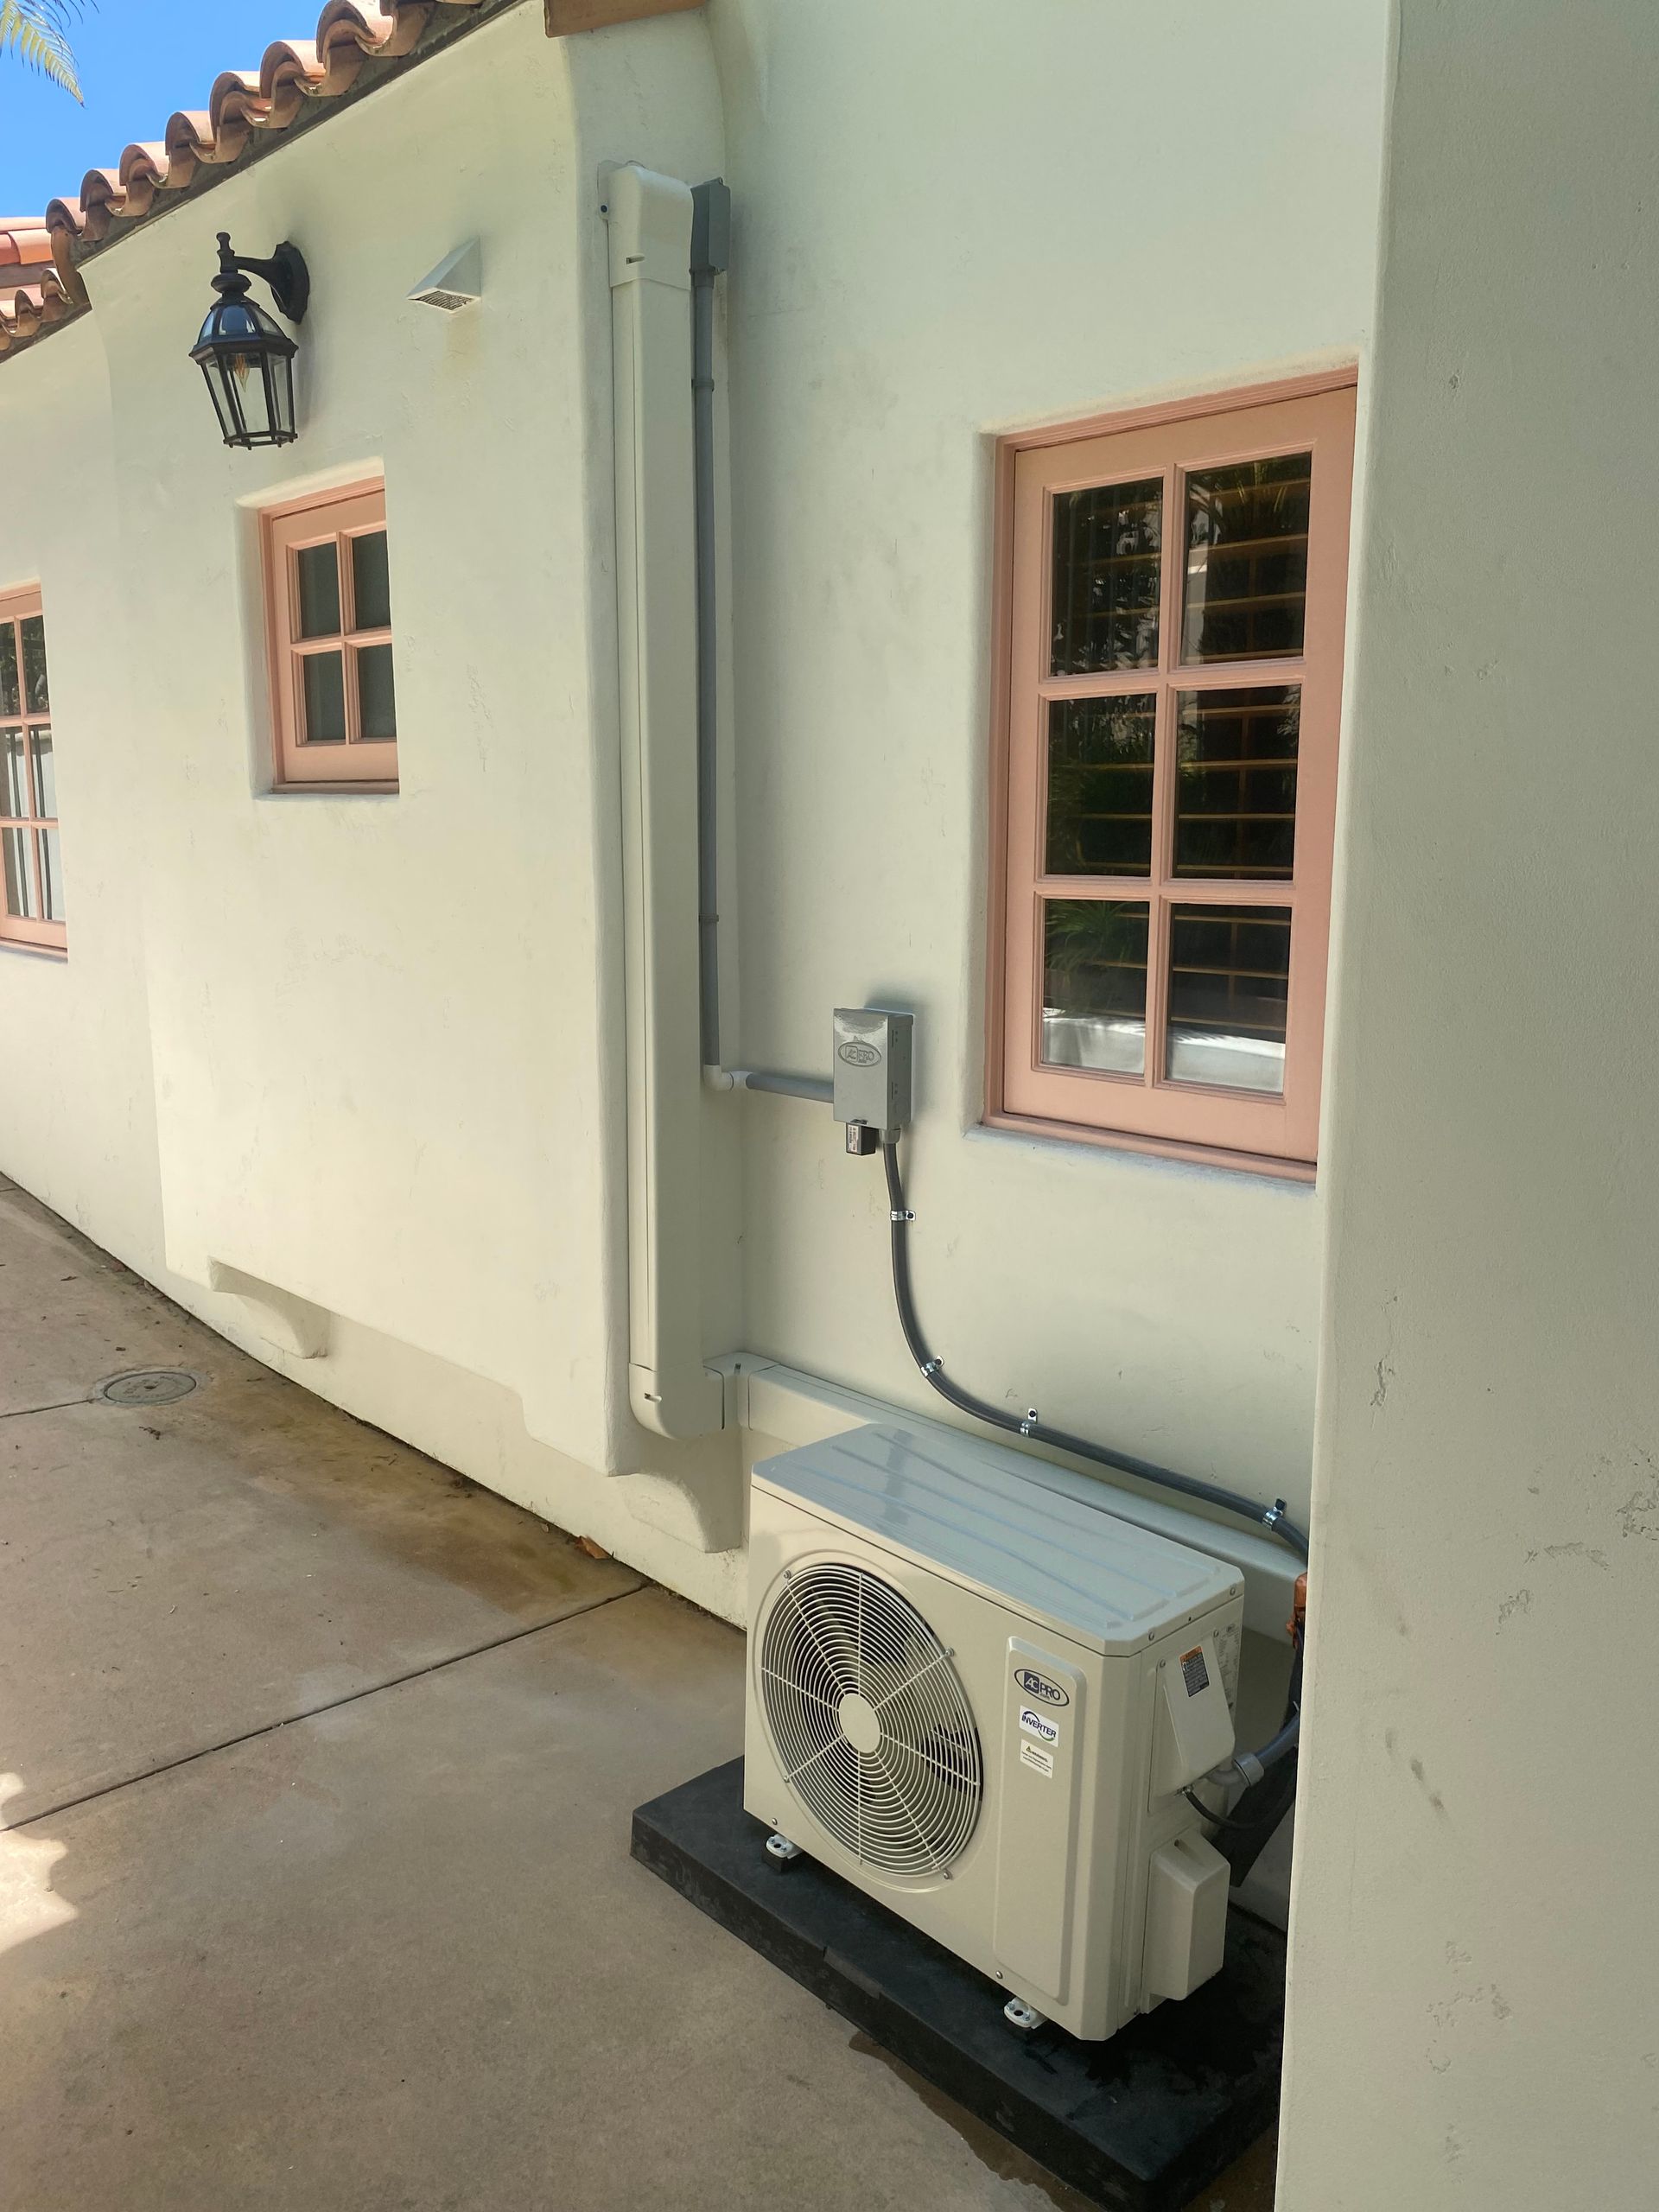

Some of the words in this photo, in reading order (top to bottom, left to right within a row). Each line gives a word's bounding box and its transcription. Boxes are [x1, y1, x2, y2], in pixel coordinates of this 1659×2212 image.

[1025, 1677, 1039, 1690] AC
[1039, 1681, 1061, 1700] PRO
[1021, 1714, 1057, 1738] INVERTER
